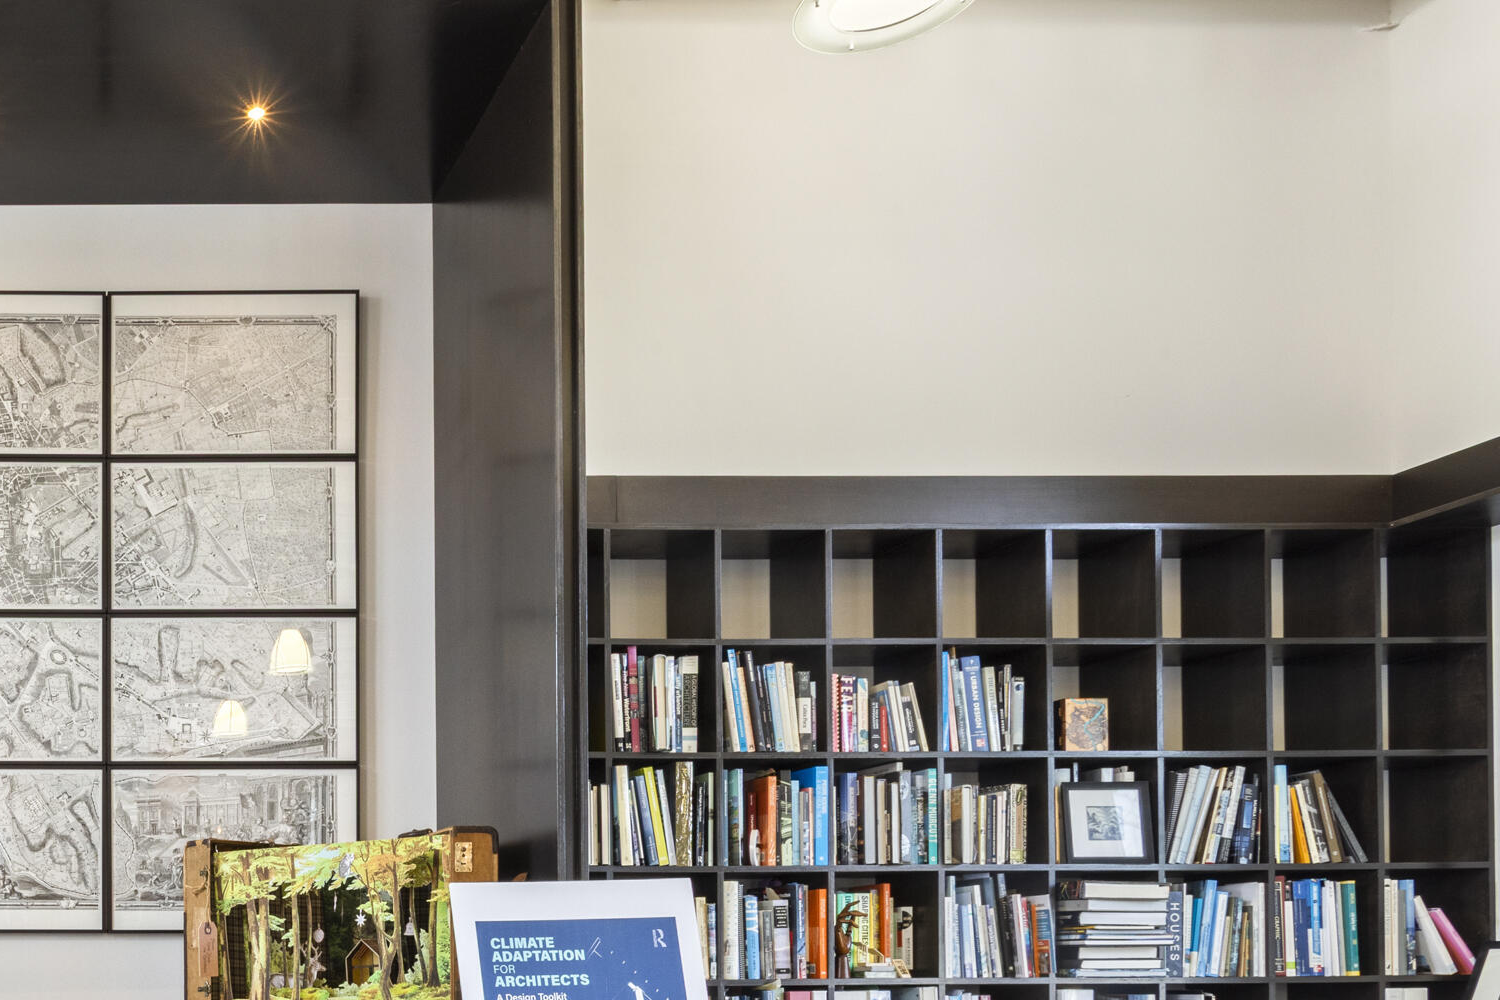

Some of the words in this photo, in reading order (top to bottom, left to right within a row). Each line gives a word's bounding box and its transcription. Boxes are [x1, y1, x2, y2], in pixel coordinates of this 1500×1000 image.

[683, 674, 691, 727] ARCHITECTURE
[970, 675, 979, 701] URBAN
[973, 702, 982, 728] DESIGN
[929, 778, 937, 804] GLENN
[745, 899, 758, 934] CITY
[861, 895, 869, 924] SHAPNG
[490, 936, 555, 949] CLIMATE
[1170, 902, 1180, 961] HOUSES
[492, 949, 586, 963] ADAPTATION
[493, 964, 516, 975] FOR
[495, 973, 590, 987] ARCHITECTS
